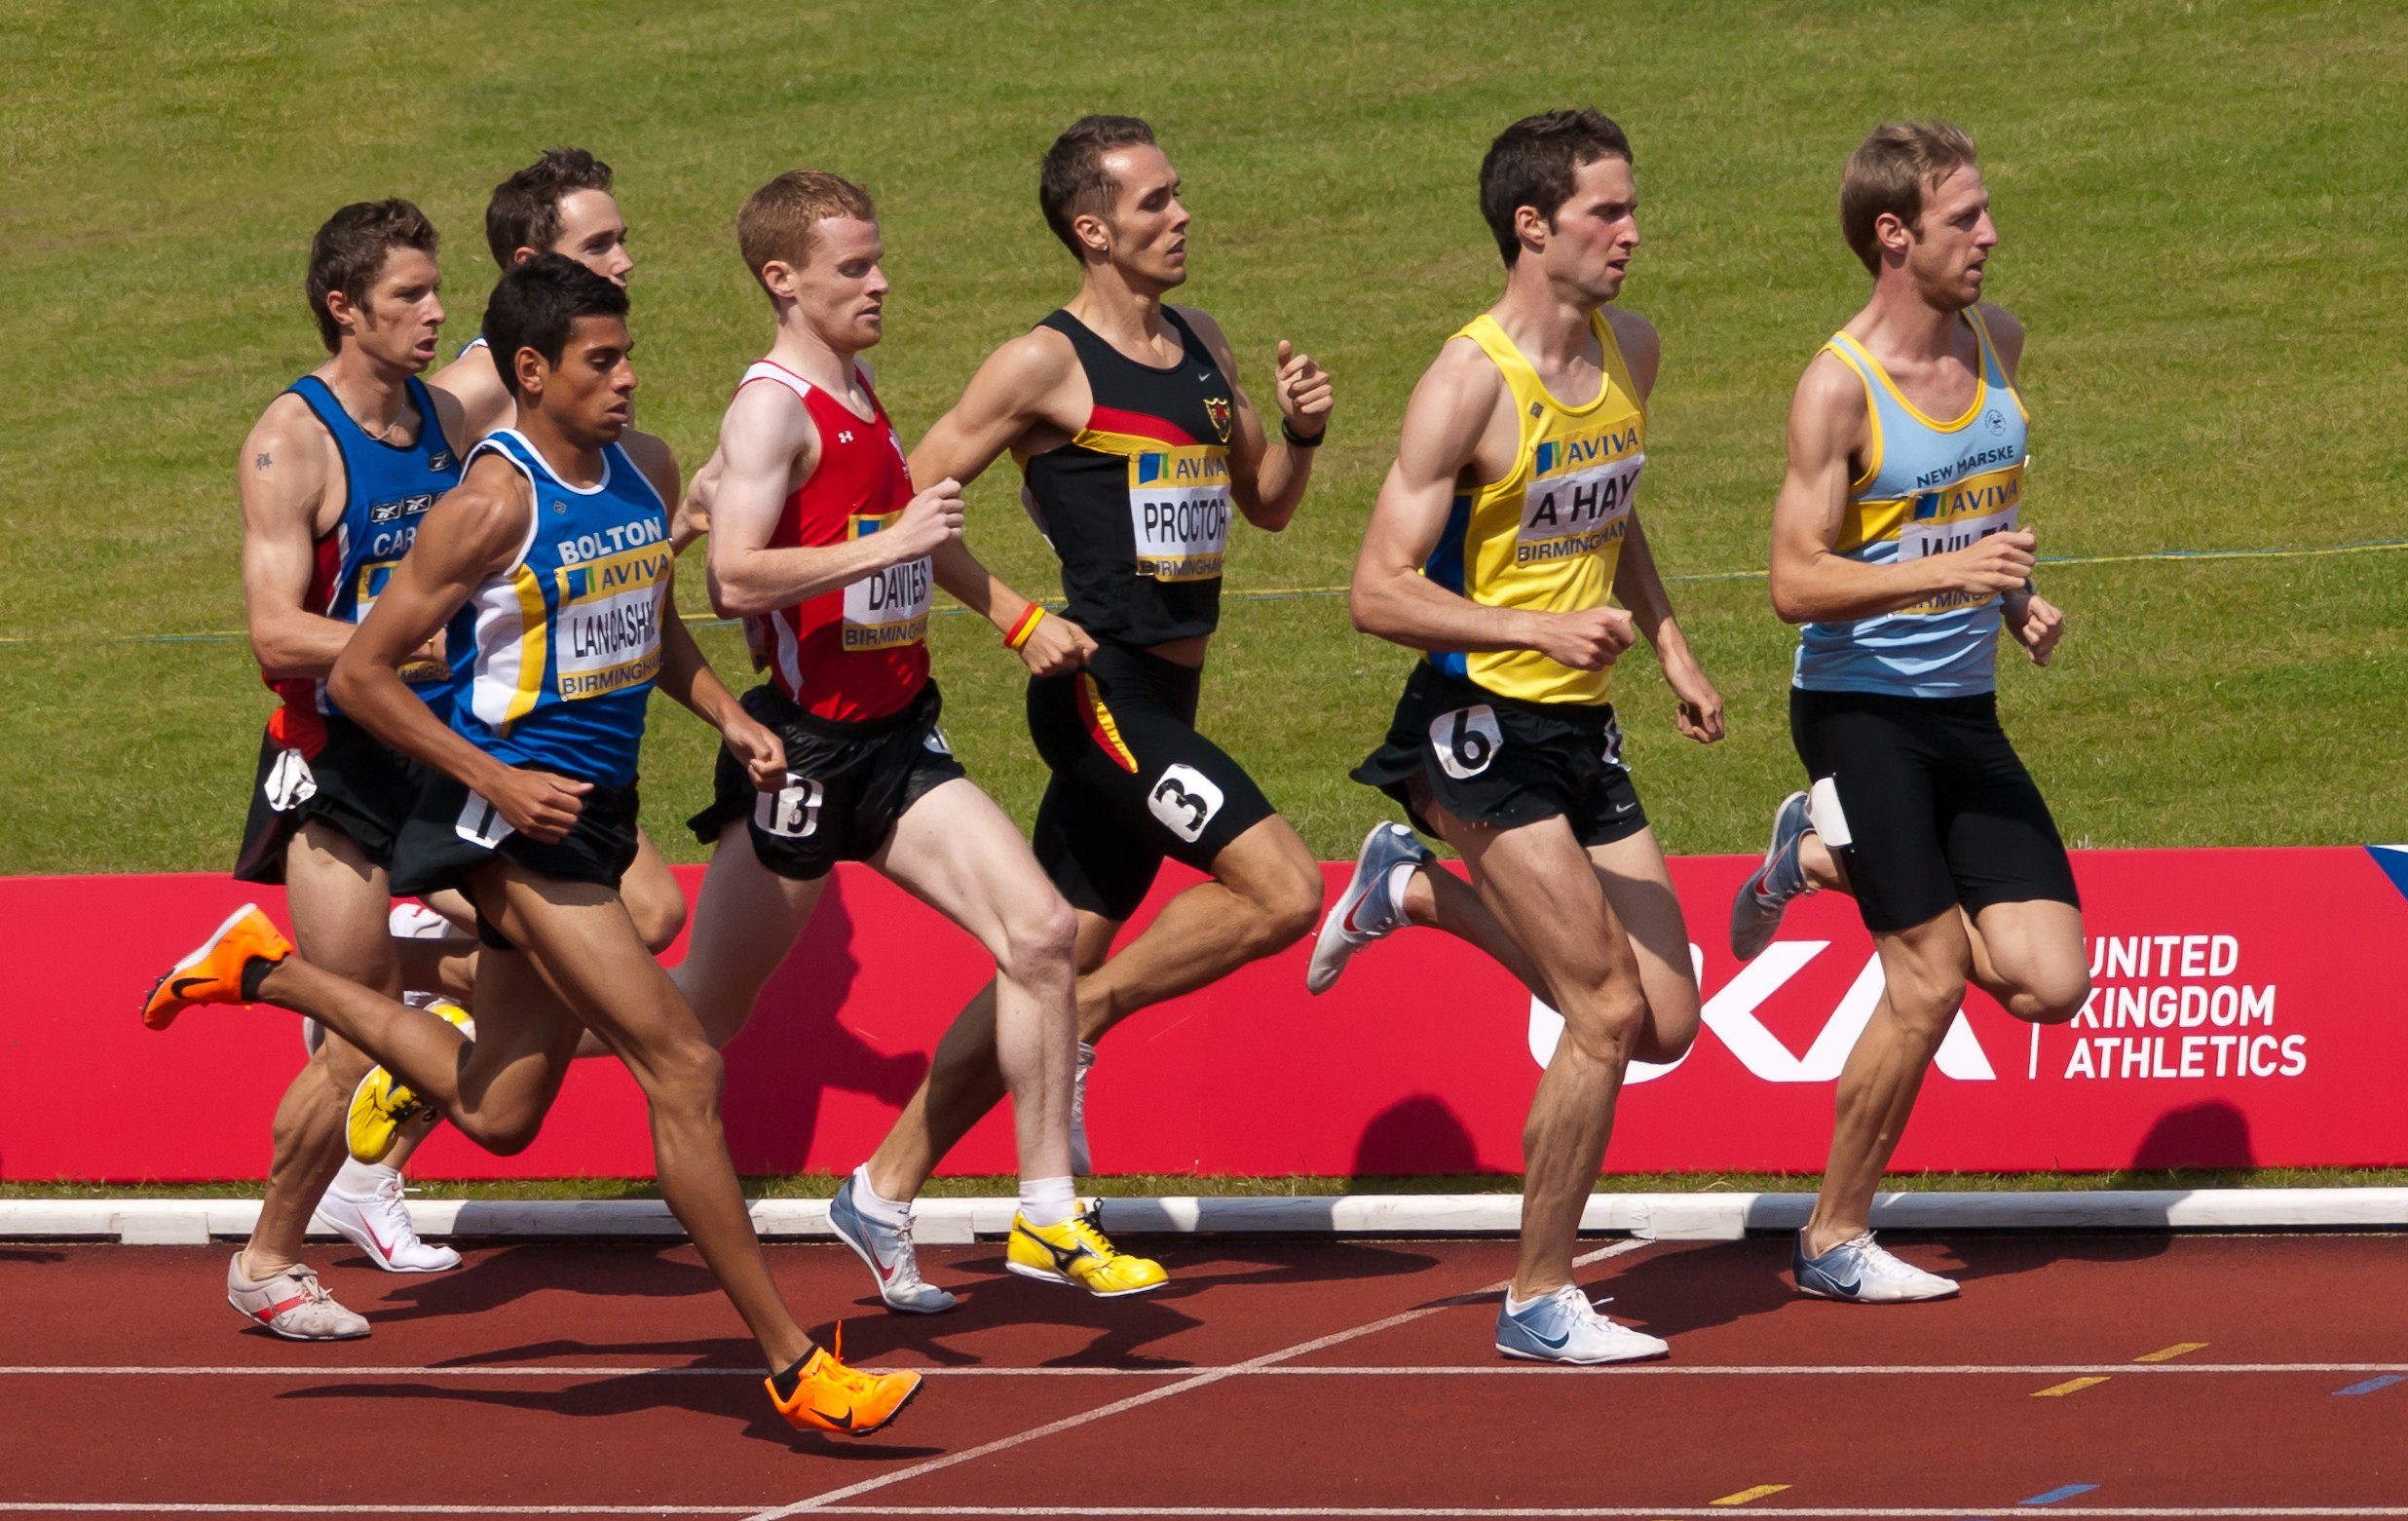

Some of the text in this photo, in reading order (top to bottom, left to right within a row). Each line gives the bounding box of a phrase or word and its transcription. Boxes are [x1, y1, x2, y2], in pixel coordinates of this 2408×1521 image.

[1177, 457, 1229, 479] AVIVA
[1568, 427, 1639, 466] AVIVA
[1916, 444, 2015, 489] NEW MARSKE
[1527, 468, 1641, 528] A HAY
[1950, 478, 2018, 515] AVIVA
[558, 516, 663, 566] BOLTON
[1144, 498, 1226, 544] PROCTOR
[601, 552, 669, 589] AVIVA
[1450, 708, 1491, 770] 6
[769, 779, 812, 833] 13
[1154, 778, 1208, 832] 3
[2070, 984, 2276, 1029] KINGDOM
[2063, 1034, 2308, 1080] ATHLETICS
